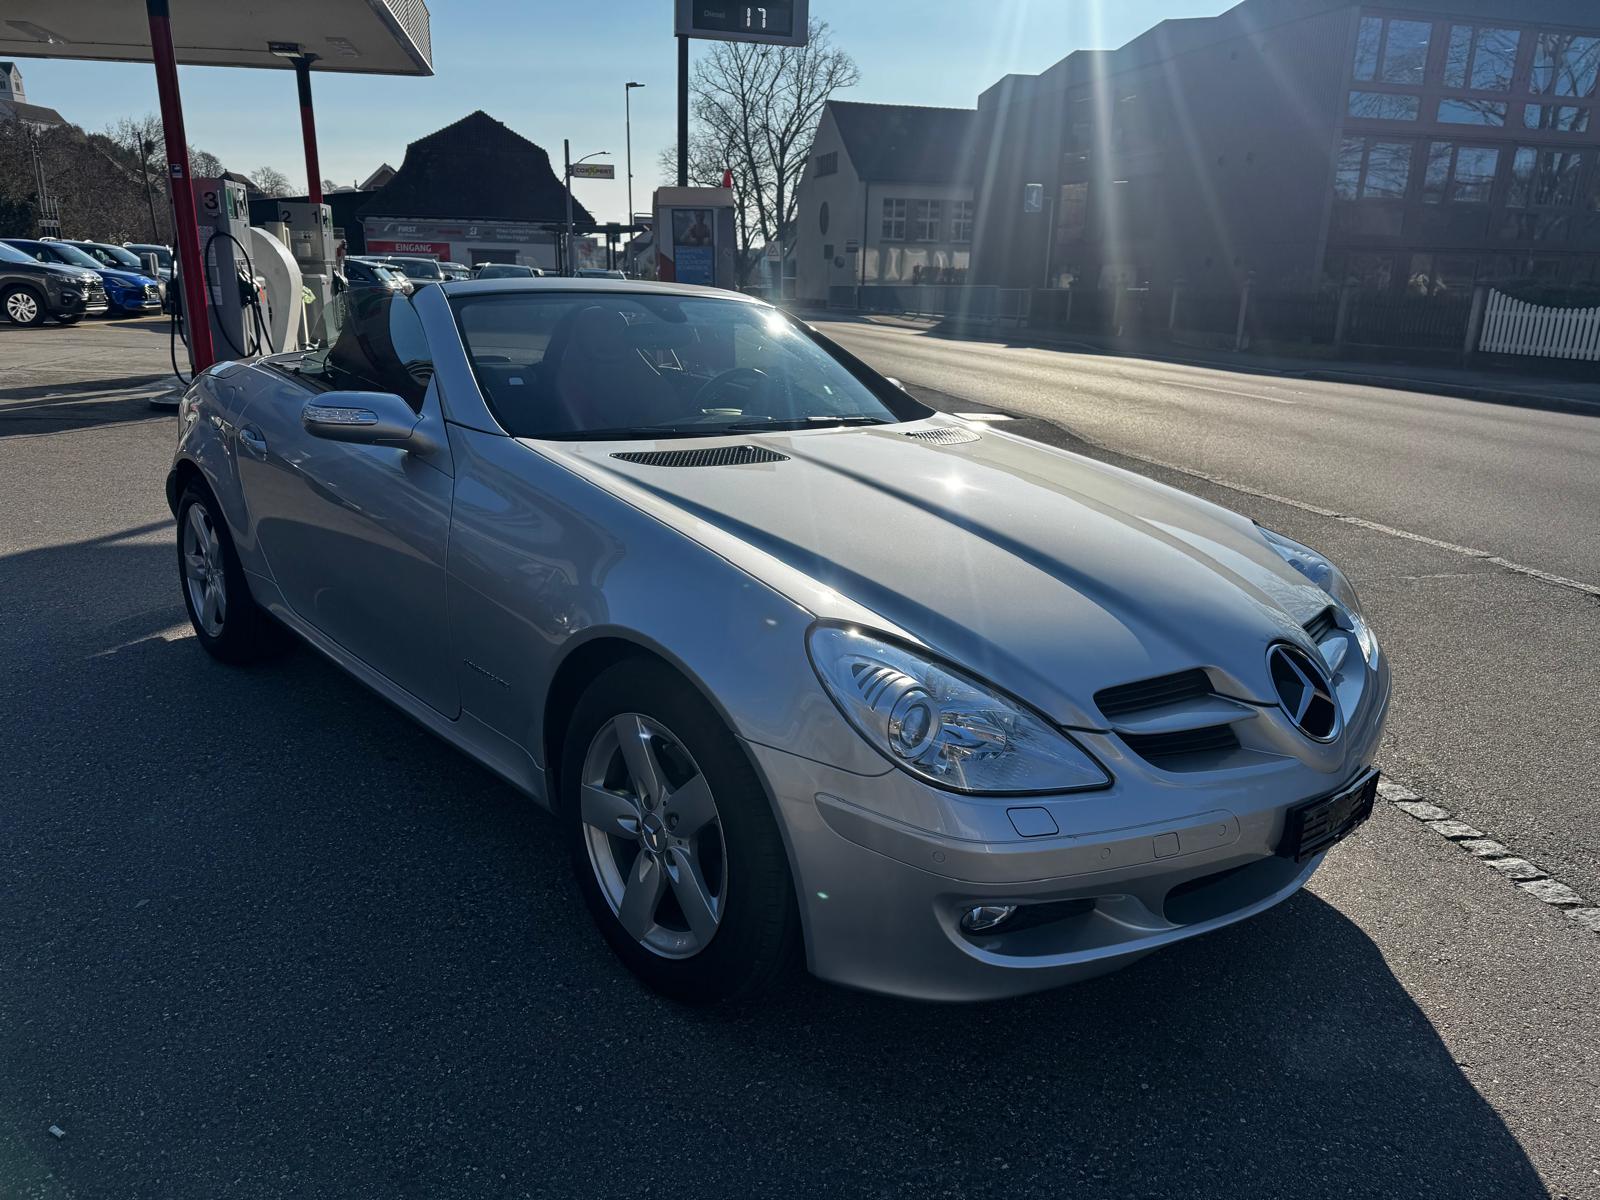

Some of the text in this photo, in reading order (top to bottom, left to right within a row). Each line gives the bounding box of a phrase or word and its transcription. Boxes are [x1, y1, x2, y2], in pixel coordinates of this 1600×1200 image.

[704, 10, 726, 18] Diesel
[204, 191, 218, 210] 3
[281, 210, 293, 223] 2
[311, 211, 319, 224] 1
[398, 225, 417, 233] FIRST
[395, 243, 432, 253] EINGANG
